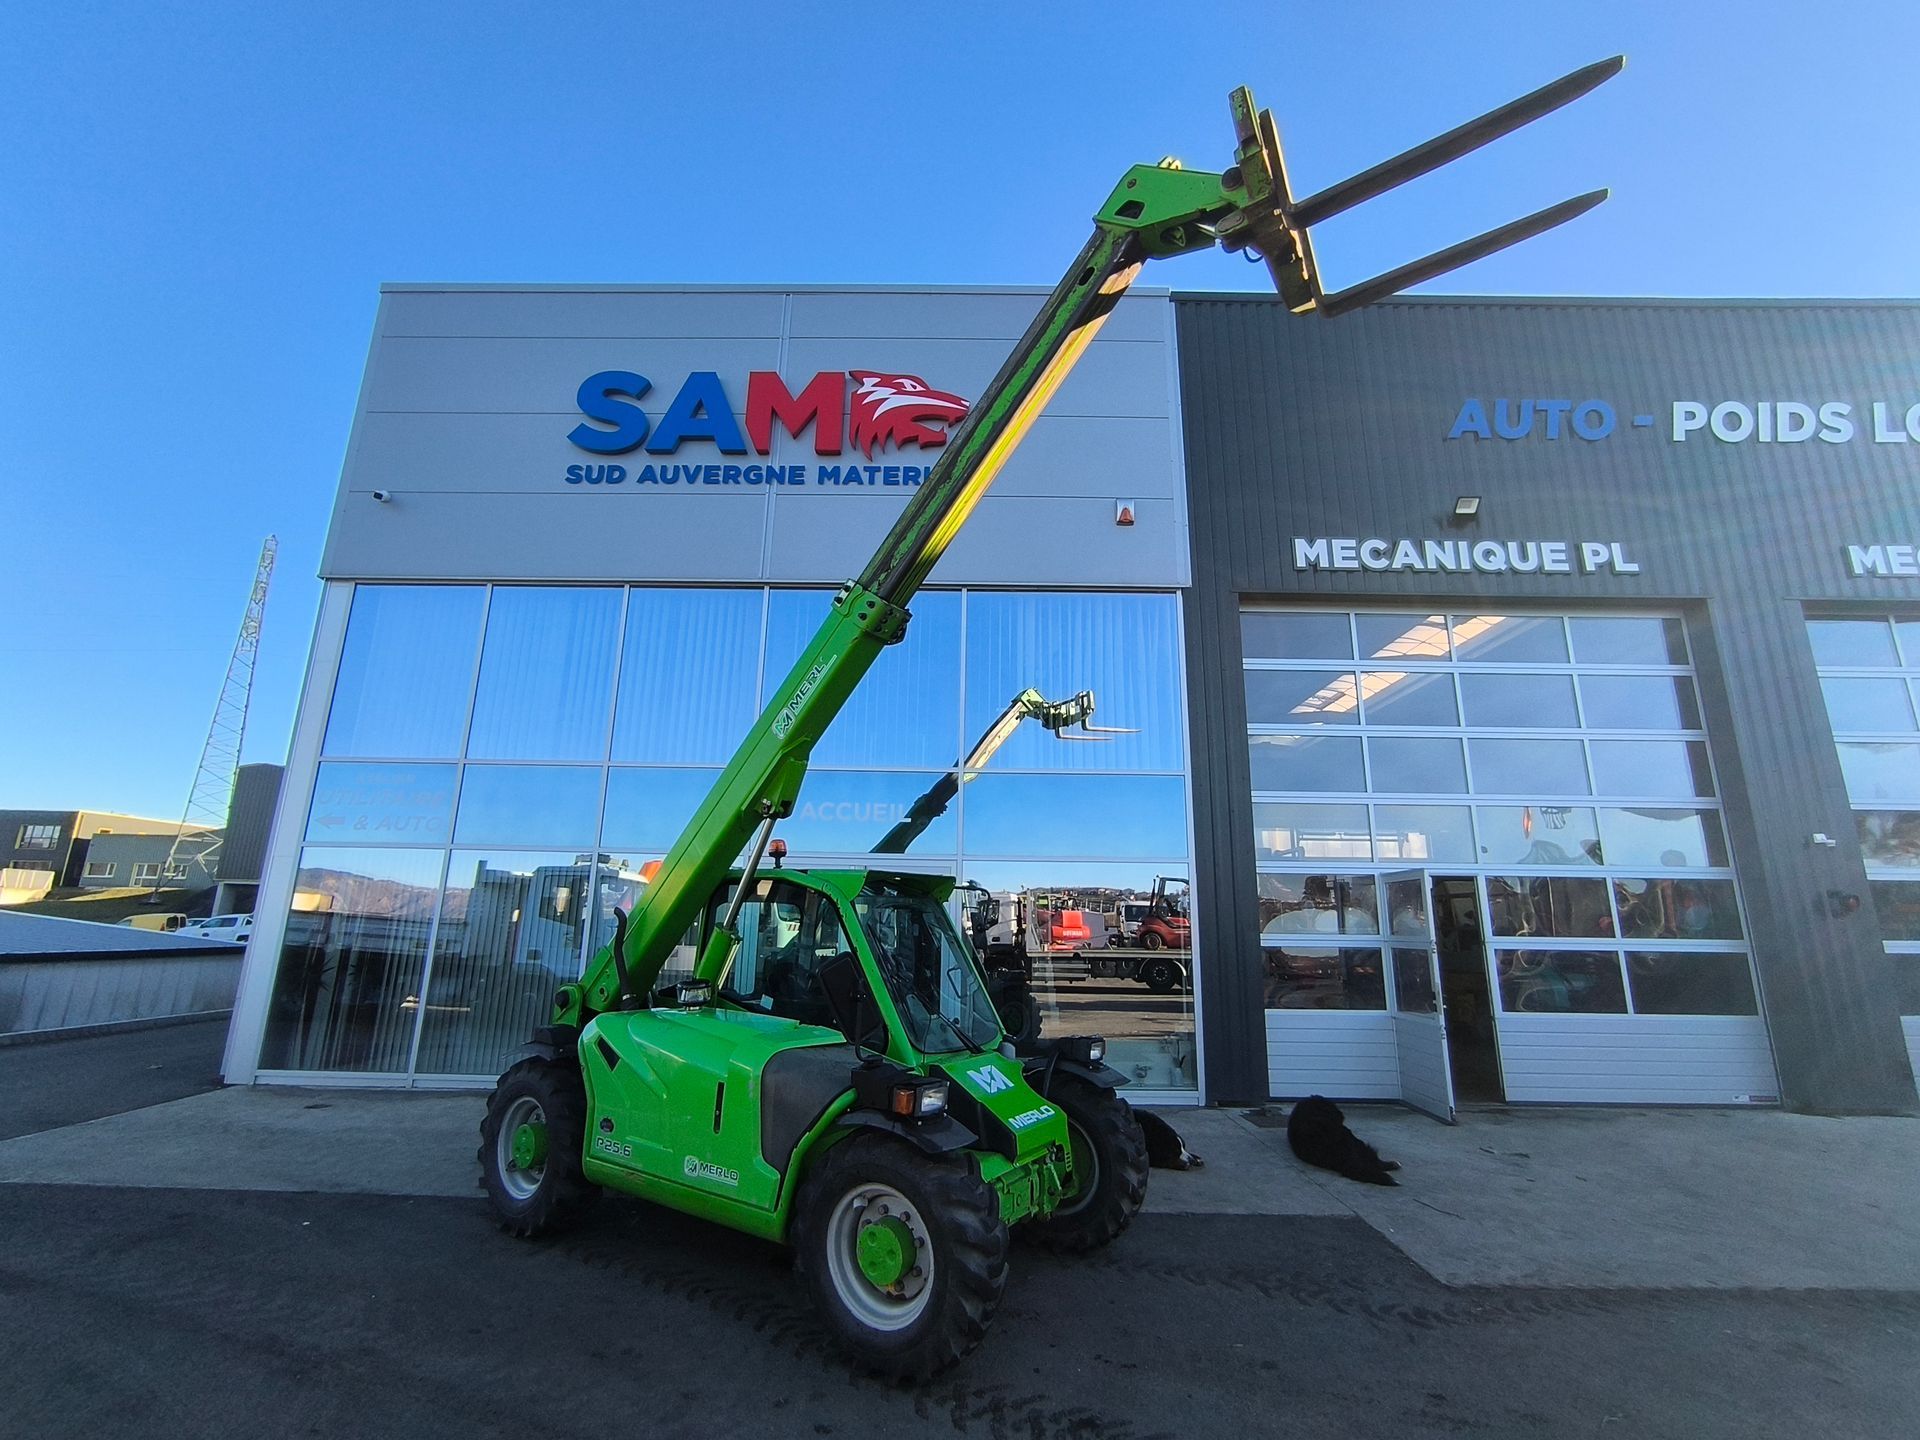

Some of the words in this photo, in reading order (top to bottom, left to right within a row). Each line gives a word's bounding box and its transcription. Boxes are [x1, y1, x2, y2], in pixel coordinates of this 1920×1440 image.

[566, 370, 847, 456] SAM
[1448, 399, 1616, 441] AUTO
[1672, 401, 1855, 443] POIDS
[565, 464, 627, 486] SUD
[637, 465, 806, 486] AUVERGNE
[818, 466, 930, 487] MATERI
[1293, 537, 1571, 574] MECANIQUE
[1581, 542, 1640, 574] PL
[1848, 544, 1920, 577] ME
[789, 656, 826, 711] MERL
[352, 815, 369, 831] &
[374, 815, 443, 832] AUTO
[800, 801, 912, 823] ACCUEIL
[1008, 1105, 1056, 1129] MERLO
[595, 1137, 632, 1157] P25.6
[700, 1162, 738, 1181] MERLO
